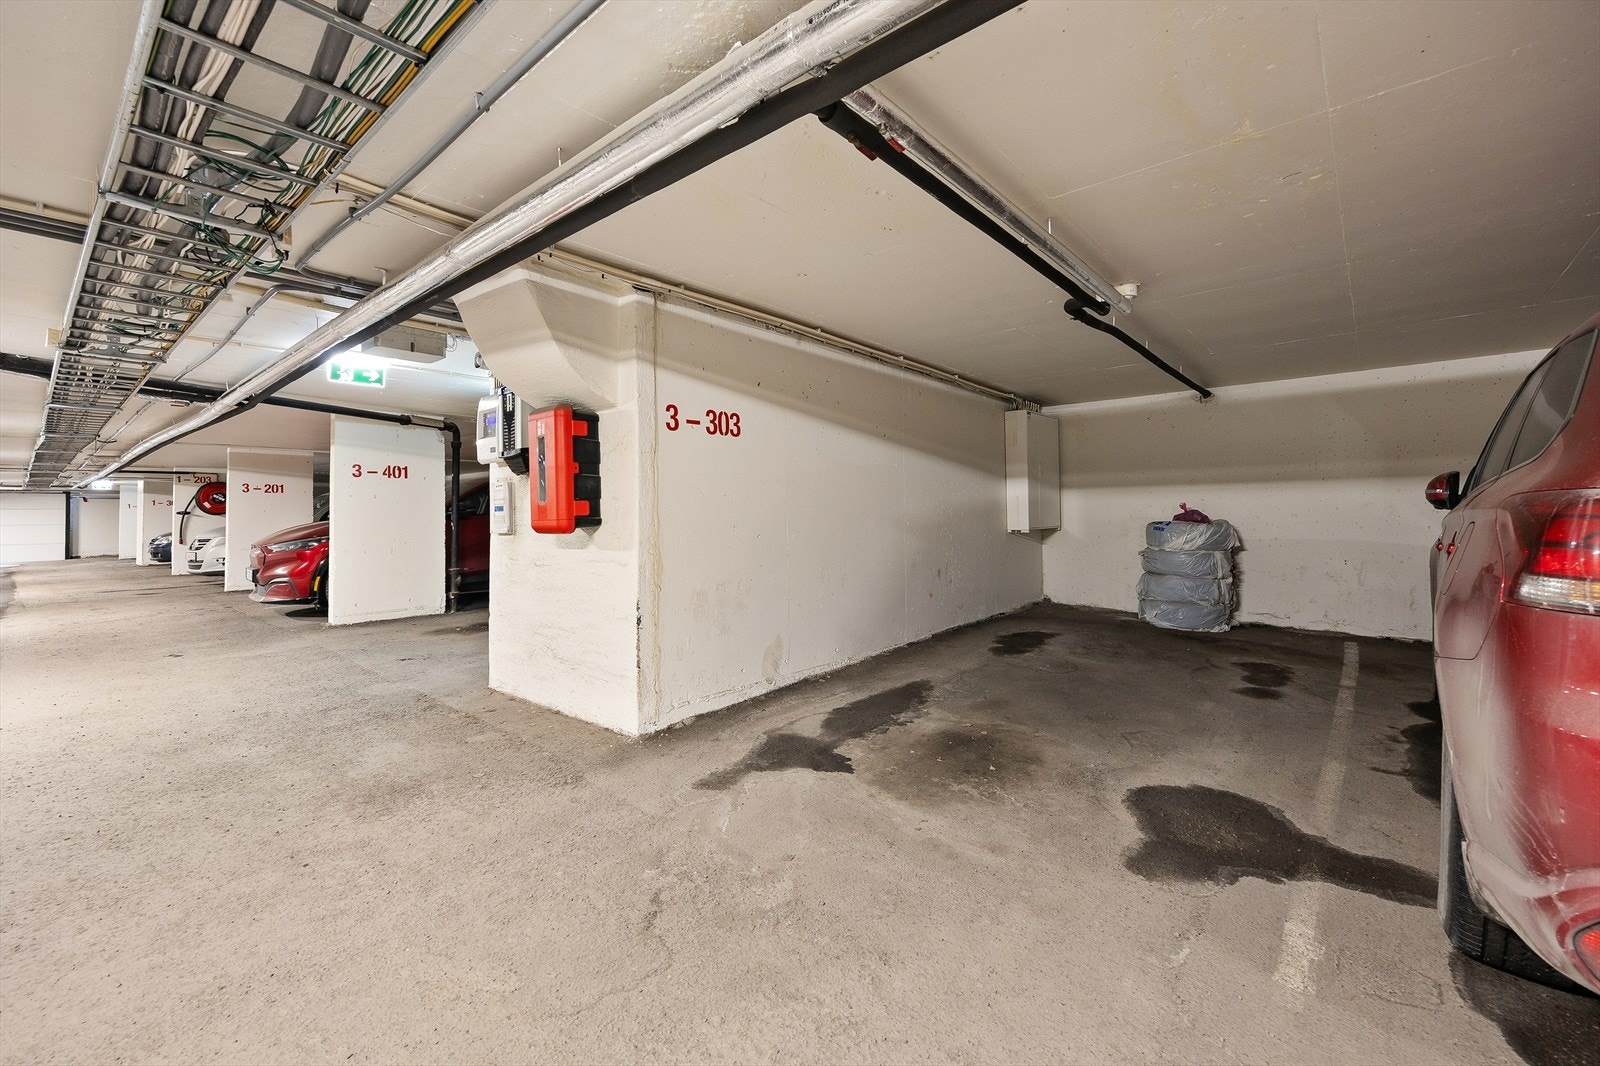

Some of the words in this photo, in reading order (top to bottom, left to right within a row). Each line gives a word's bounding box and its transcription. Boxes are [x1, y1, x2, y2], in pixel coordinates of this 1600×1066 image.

[705, 409, 741, 437] 303
[382, 465, 408, 479] 401
[264, 484, 284, 495] 201
